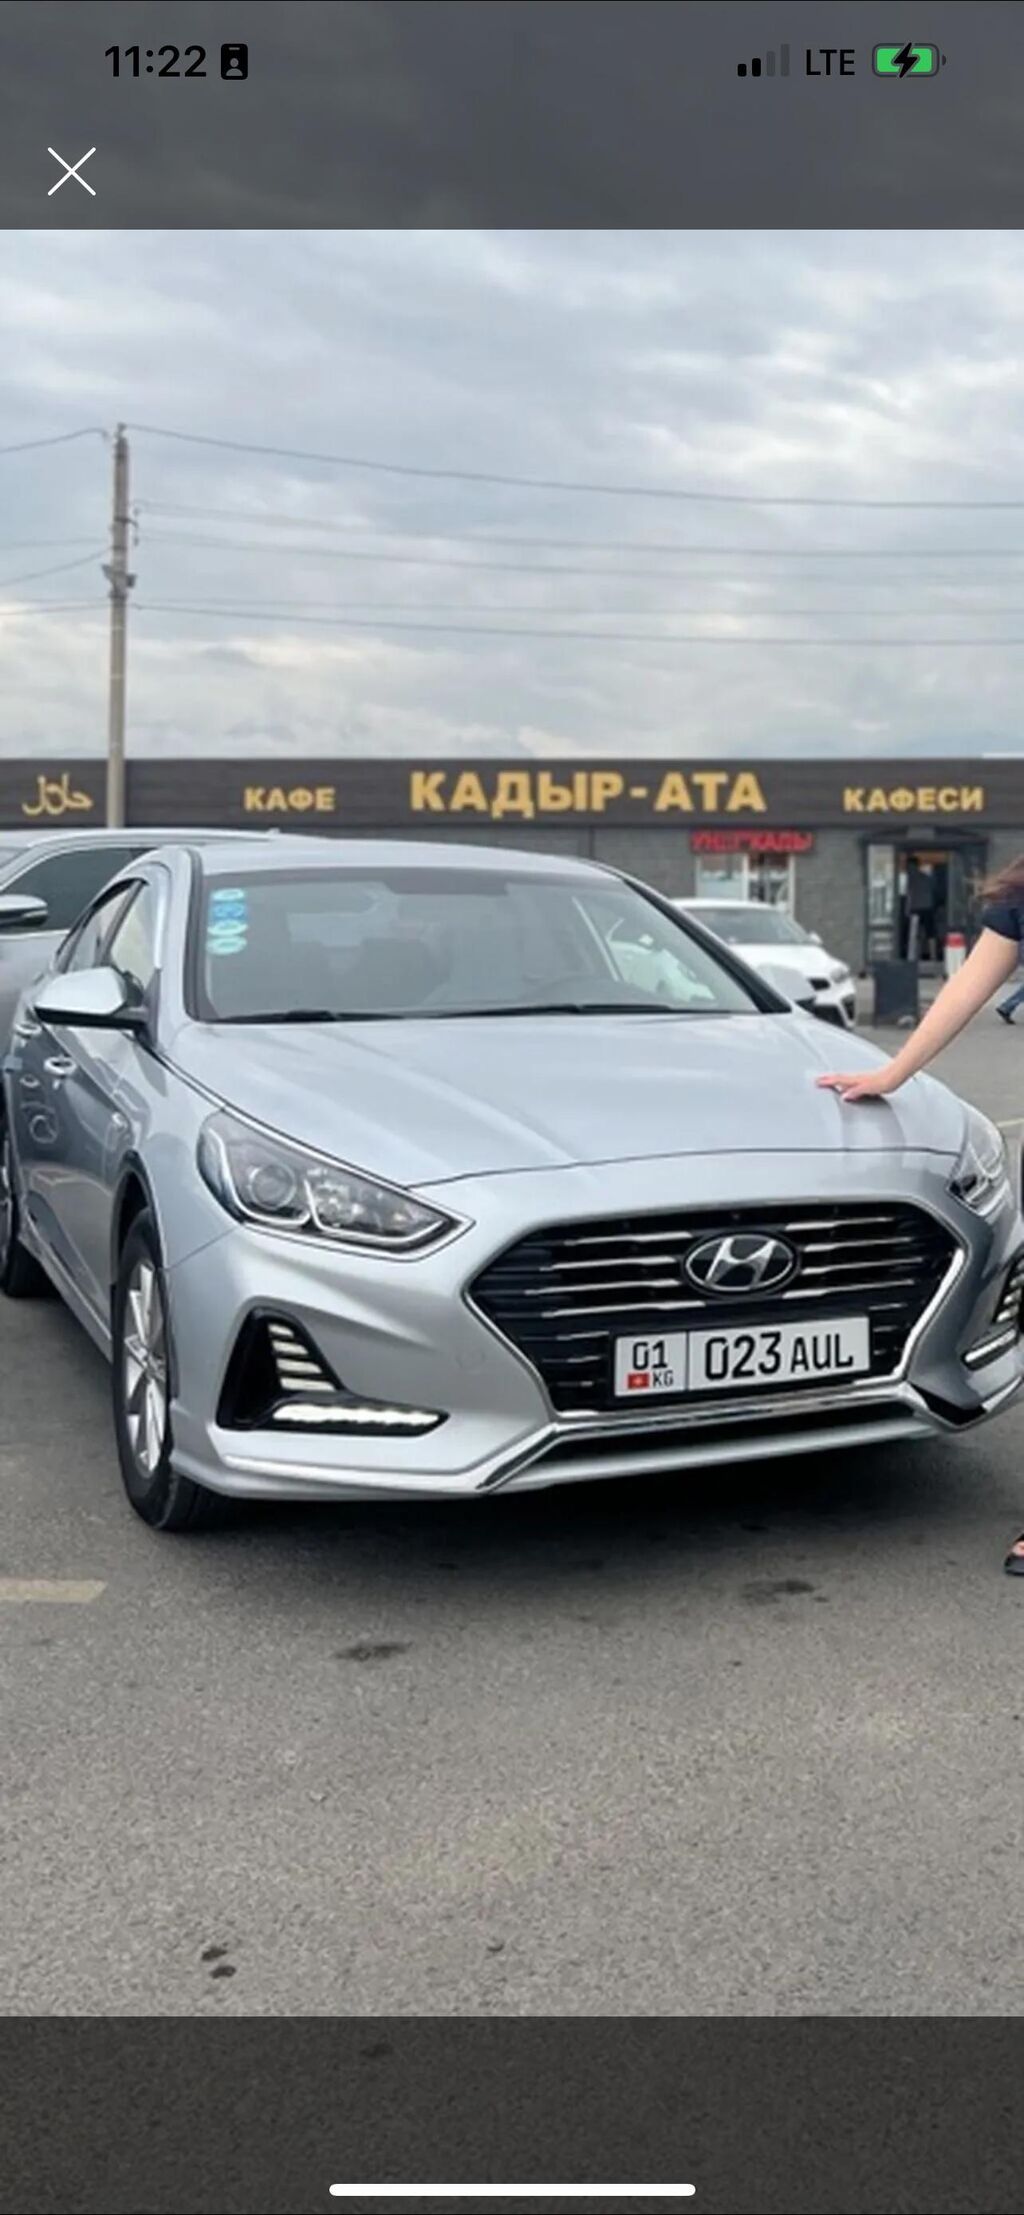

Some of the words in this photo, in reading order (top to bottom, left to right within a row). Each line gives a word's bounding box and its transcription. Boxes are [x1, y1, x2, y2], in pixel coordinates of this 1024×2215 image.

[243, 786, 335, 812] КАФЕ
[409, 769, 767, 818] КАДЫР-АТА
[842, 786, 984, 812] КАФЕСИ
[631, 1340, 668, 1371] 01
[704, 1331, 782, 1380] 023
[790, 1333, 854, 1373] AUL
[652, 1370, 674, 1387] KG
